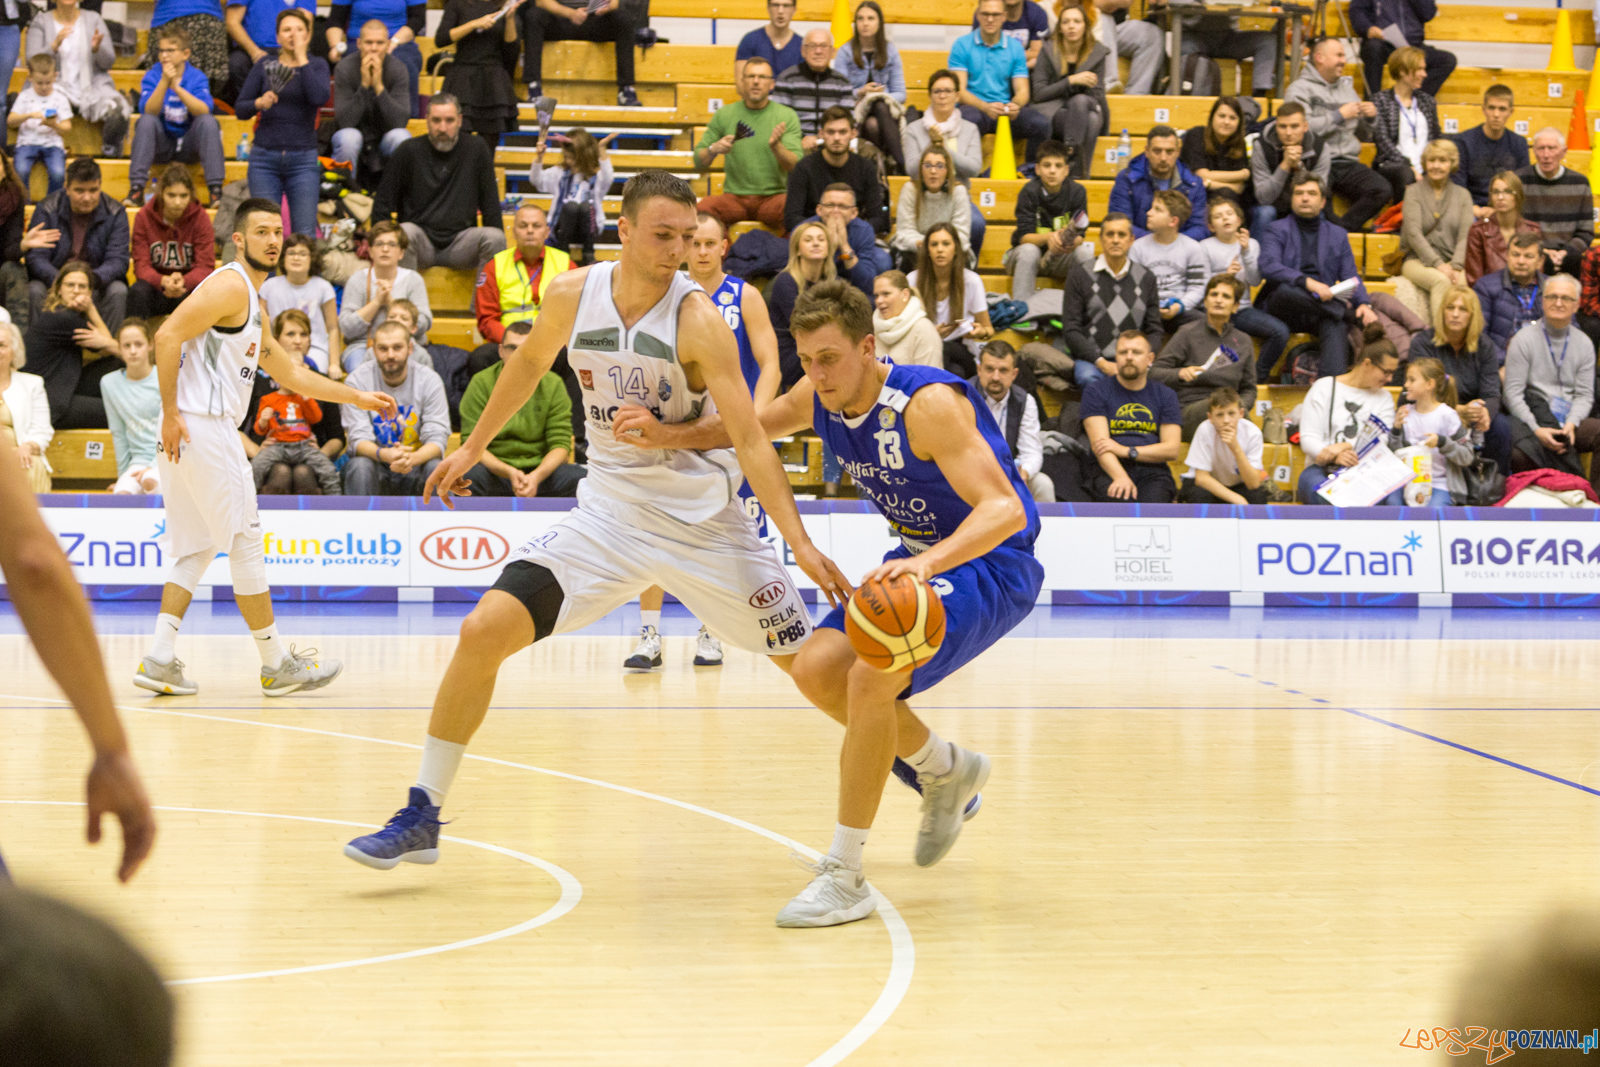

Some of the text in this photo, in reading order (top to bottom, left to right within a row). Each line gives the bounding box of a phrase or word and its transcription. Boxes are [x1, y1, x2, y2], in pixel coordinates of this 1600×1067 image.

[1446, 121, 1457, 130] 14
[1110, 151, 1116, 161] 3
[985, 193, 991, 204] 5
[579, 338, 615, 347] macron
[608, 366, 650, 400] 14
[89, 443, 101, 457] 15
[873, 429, 905, 470] 13
[1279, 468, 1286, 480] 3
[263, 532, 402, 556] funclub
[436, 537, 495, 560] KIA
[264, 556, 401, 567] biuro podróży
[1115, 558, 1173, 574] HOTEL
[1465, 570, 1500, 579] POLSKI
[1506, 570, 1564, 579] PRODUCENT
[755, 585, 783, 606] KIA
[759, 602, 797, 629] DELIK
[777, 620, 806, 646] PBG
